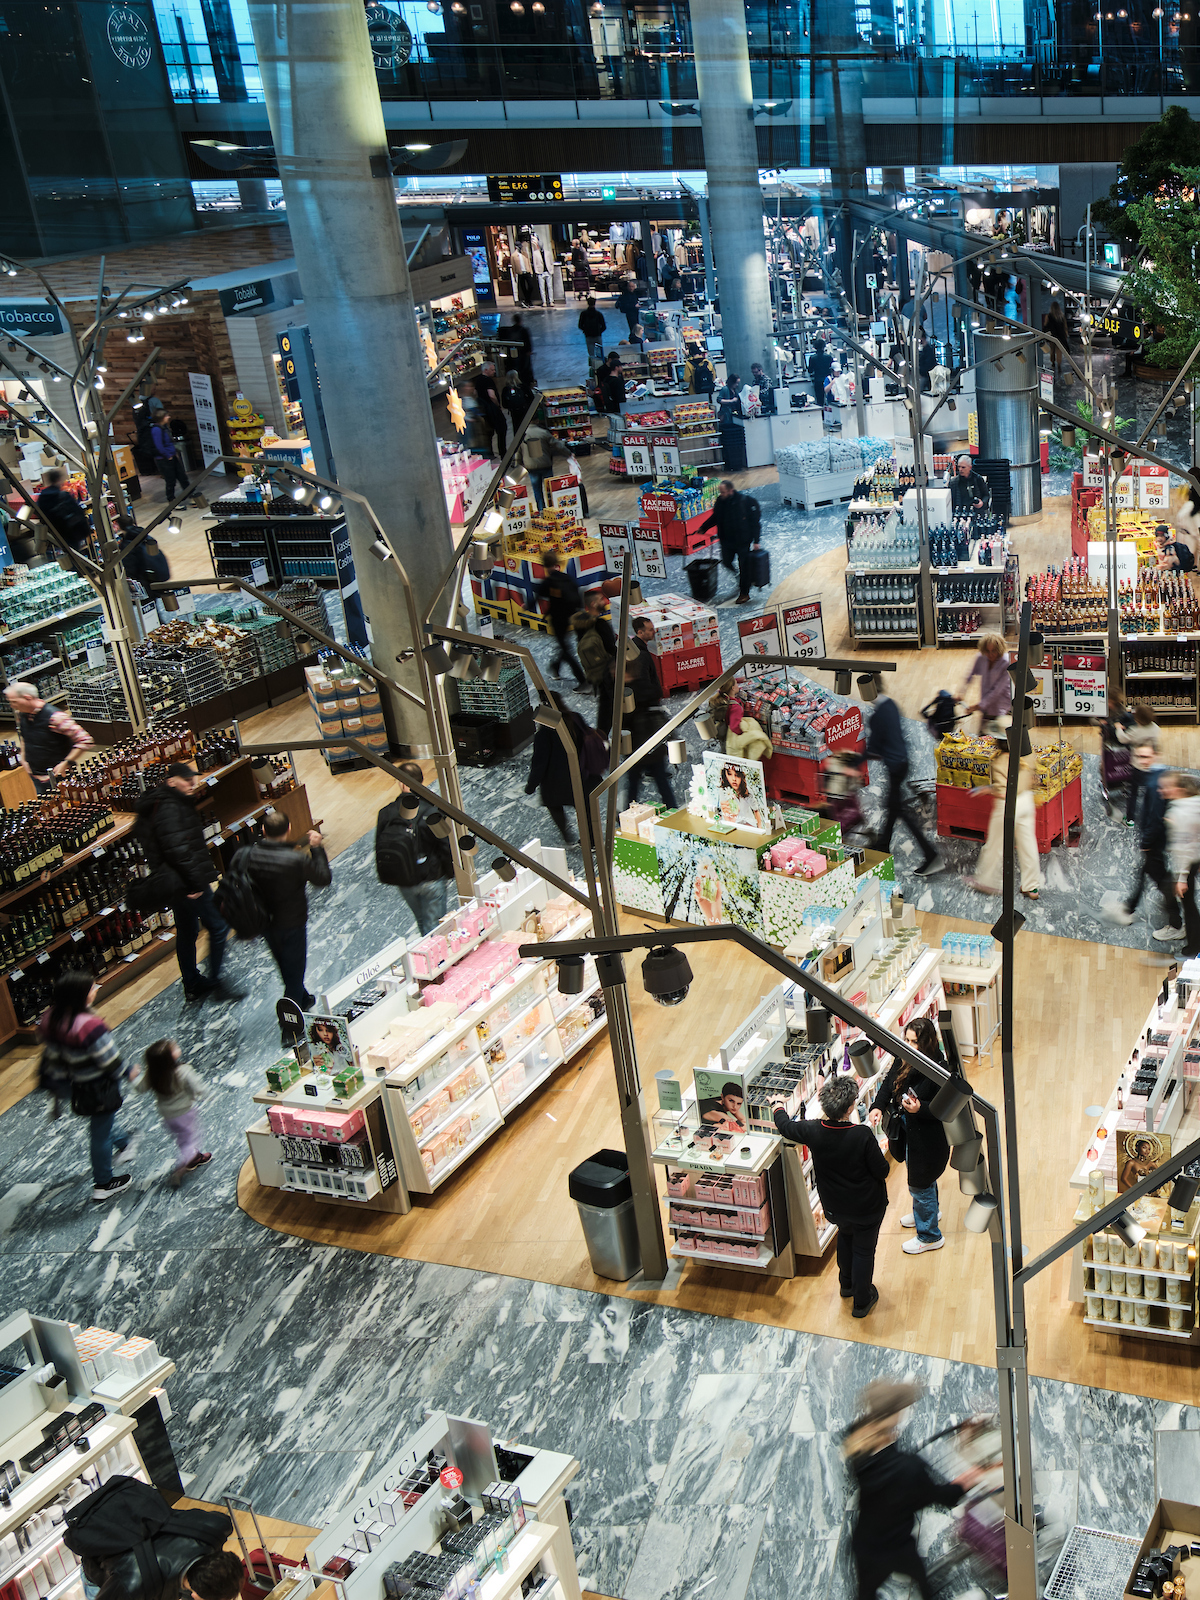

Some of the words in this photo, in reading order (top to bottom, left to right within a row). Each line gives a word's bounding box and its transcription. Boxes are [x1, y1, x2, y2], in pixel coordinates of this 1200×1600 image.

[234, 284, 257, 301] Tobakk
[0, 310, 55, 323] Tobacco
[623, 437, 645, 445] SALE
[654, 437, 675, 446] SALE
[267, 454, 296, 464] Holiday
[630, 465, 643, 473] 119
[1149, 497, 1160, 505] 89
[507, 521, 523, 531] 149
[602, 526, 625, 536] SALE
[635, 529, 658, 540] SALE
[646, 564, 657, 573] 89
[789, 609, 801, 617] TAX
[802, 605, 816, 614] FREE
[786, 611, 819, 624] FAVOURITE
[794, 647, 814, 658] 199
[677, 660, 690, 668] TAX
[1075, 701, 1091, 712] 99
[827, 723, 842, 736] TAX
[842, 713, 860, 728] FREE
[828, 722, 860, 744] FAVOURITES
[356, 962, 380, 985] Chloé
[283, 1012, 298, 1024] NEW
[733, 1023, 757, 1051] CAROLINA
[376, 1151, 390, 1187] LANDED
[386, 1158, 397, 1180] JUST
[354, 1451, 417, 1524] GUCCI
